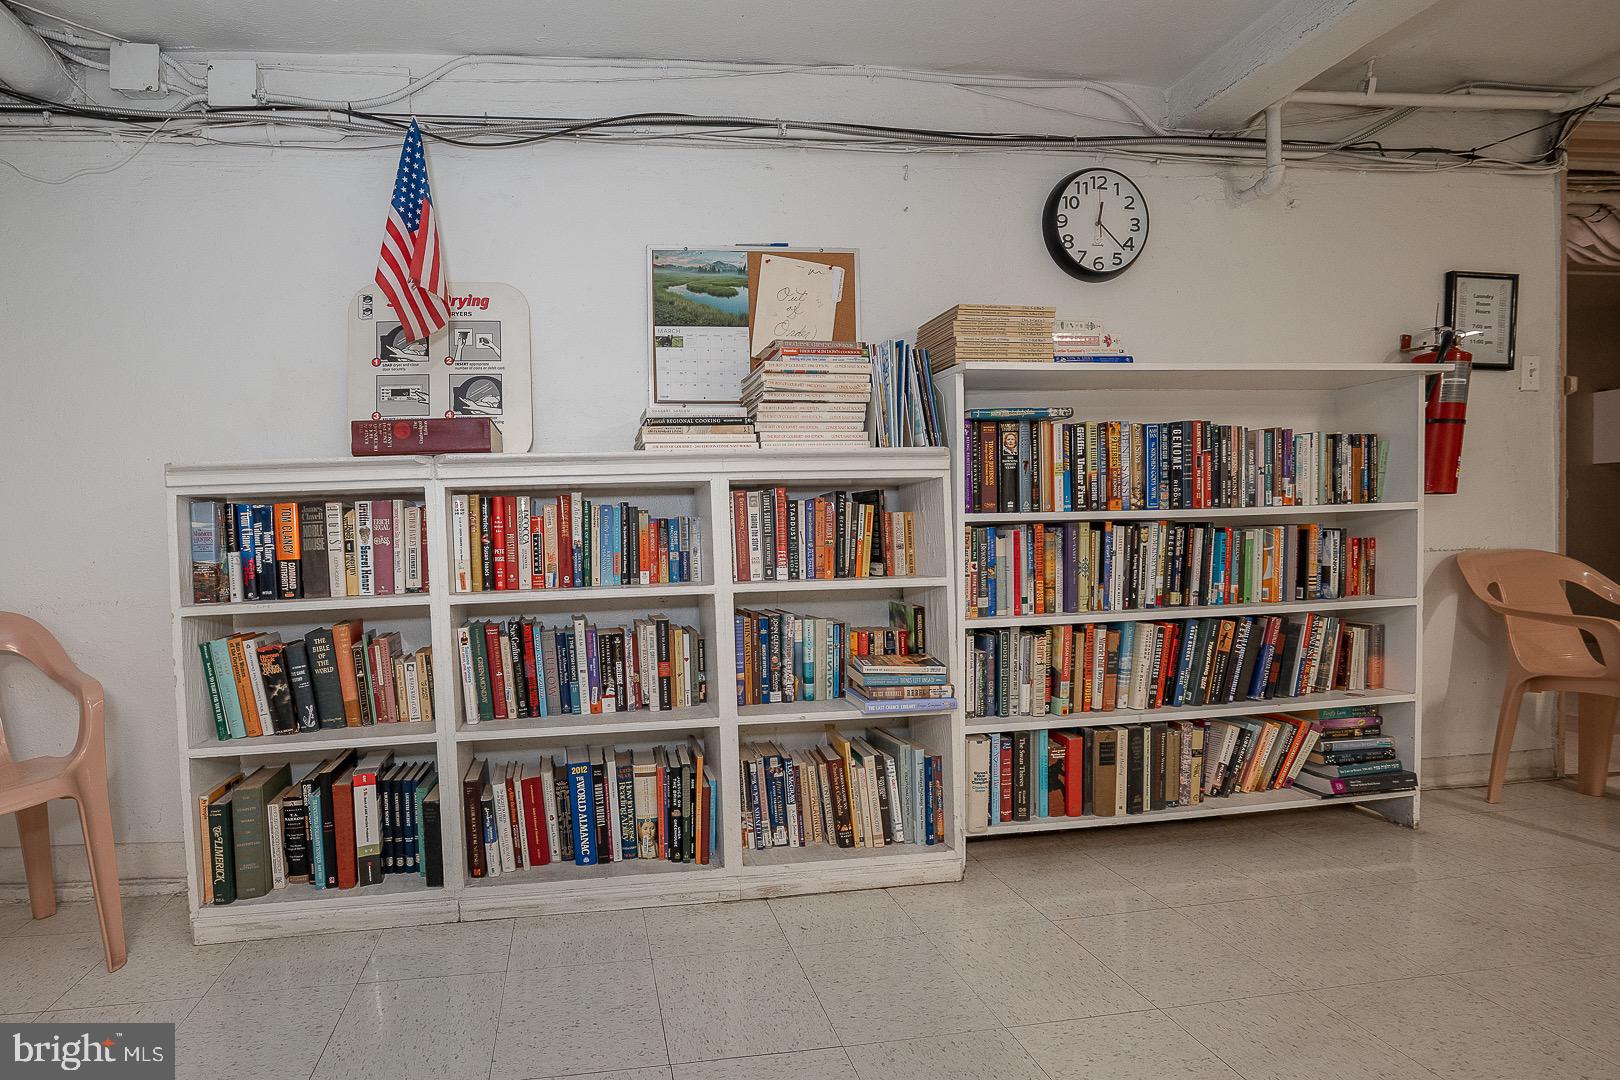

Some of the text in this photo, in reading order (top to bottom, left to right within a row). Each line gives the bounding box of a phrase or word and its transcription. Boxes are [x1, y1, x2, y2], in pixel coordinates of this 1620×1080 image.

[1075, 181, 1088, 195] 11
[1090, 176, 1108, 190] 12
[1113, 182, 1120, 196] 1
[1062, 195, 1080, 210] 10
[1124, 196, 1135, 210] 2
[1057, 213, 1068, 228] 9
[1130, 217, 1141, 232] 3
[1062, 234, 1075, 249] 8
[1123, 237, 1135, 251] 4
[1077, 250, 1087, 264] 7
[1093, 256, 1105, 271] 6
[1112, 252, 1123, 266] 5
[450, 293, 490, 311] rying
[1172, 429, 1182, 471] GENOME
[1077, 426, 1087, 505] Griffin Under Fire
[359, 503, 370, 527] Griffin
[281, 508, 294, 555] TOM CLANCY
[326, 505, 342, 553] AUGUST
[522, 510, 530, 545] IACOCCA
[264, 544, 275, 564] Clancy
[361, 545, 371, 569] Secret
[280, 561, 290, 591] AUTHORITY
[288, 562, 298, 590] COMMAND
[311, 645, 331, 653] BIBLE
[314, 638, 327, 646] THE
[511, 637, 520, 663] Grafton
[1234, 623, 1247, 655] ZEALOT
[1152, 639, 1164, 679] LIGHTKEEPERS
[1200, 641, 1215, 690] TRAVELING BLACK
[1303, 660, 1311, 674] FIRE
[314, 667, 334, 675] WORLD
[547, 649, 557, 698] TUROW
[479, 676, 488, 704] MONDAY
[1084, 679, 1092, 704] EXPOSED
[1019, 738, 1027, 747] The
[1237, 736, 1250, 764] LIBRARIAN
[571, 765, 589, 775] 2012
[1216, 764, 1226, 783] POLAND
[576, 781, 590, 855] WORLD ALMANAC
[619, 782, 629, 842] Reading Ability
[627, 807, 636, 842] Increase
[214, 839, 225, 886] LIMERICK
